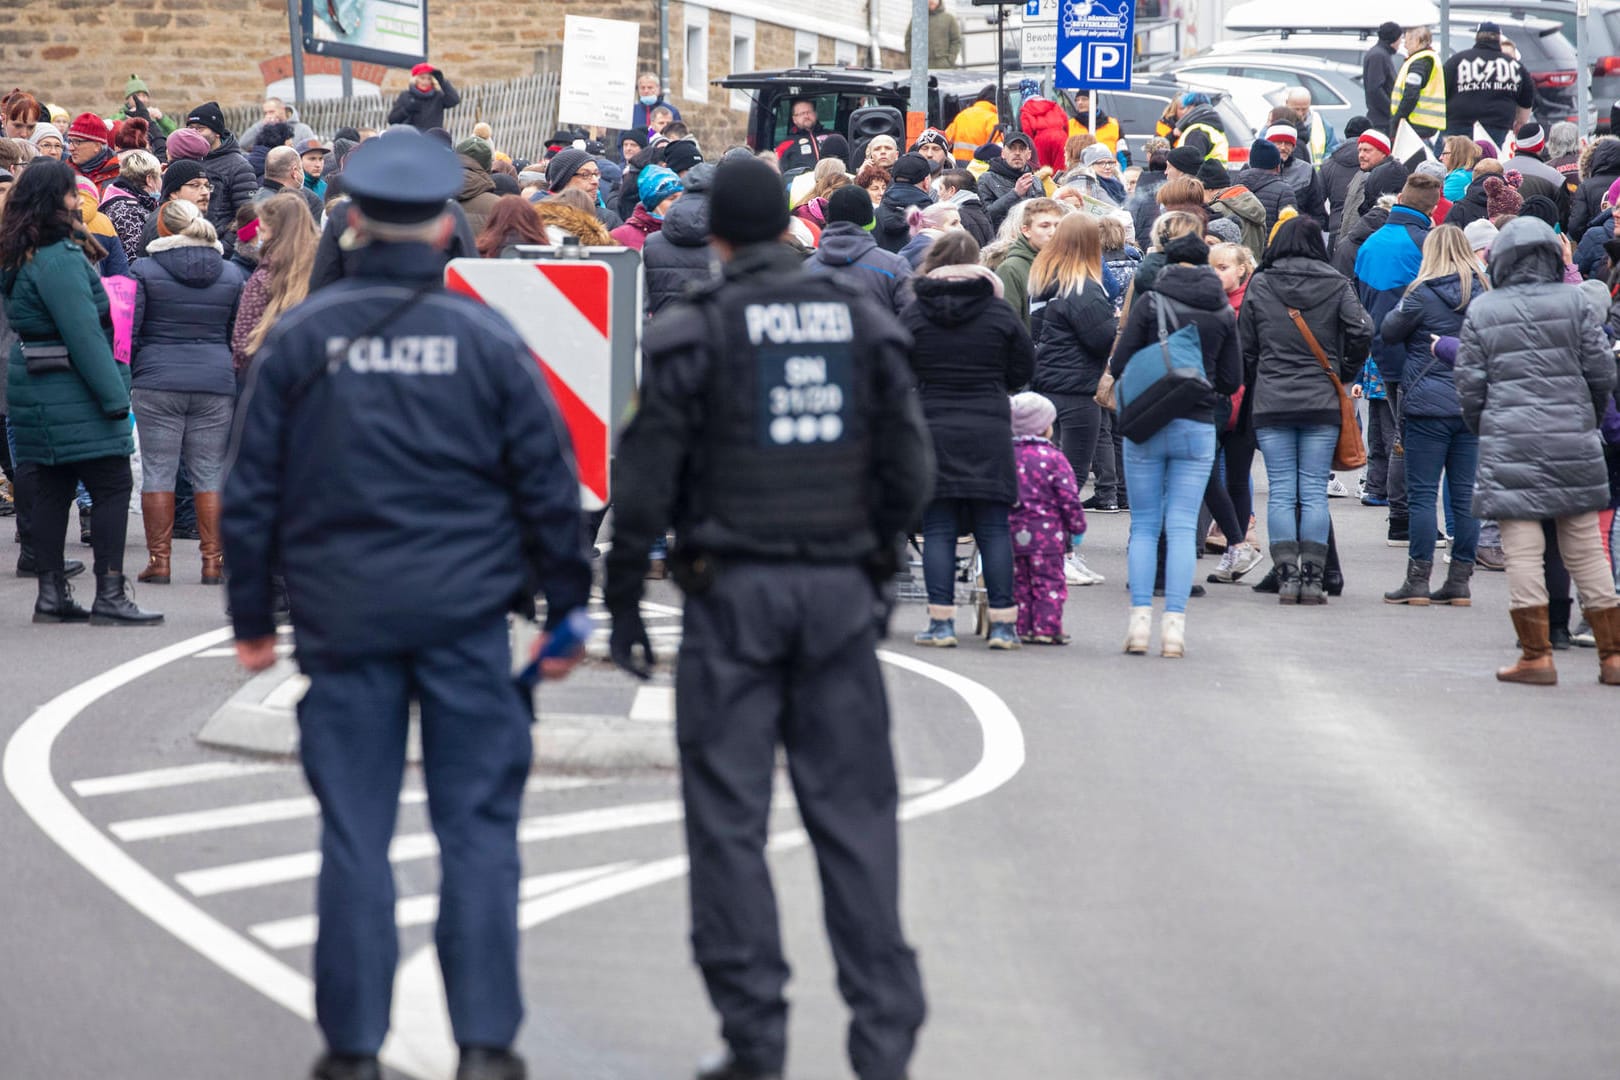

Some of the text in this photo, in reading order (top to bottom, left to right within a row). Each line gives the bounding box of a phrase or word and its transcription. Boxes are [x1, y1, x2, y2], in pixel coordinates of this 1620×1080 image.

[1094, 46, 1120, 78] P
[1457, 81, 1520, 93] BACK IN BLACK
[745, 302, 854, 345] POLIZEI
[325, 336, 457, 375] POLIZEI
[785, 355, 827, 387] SN
